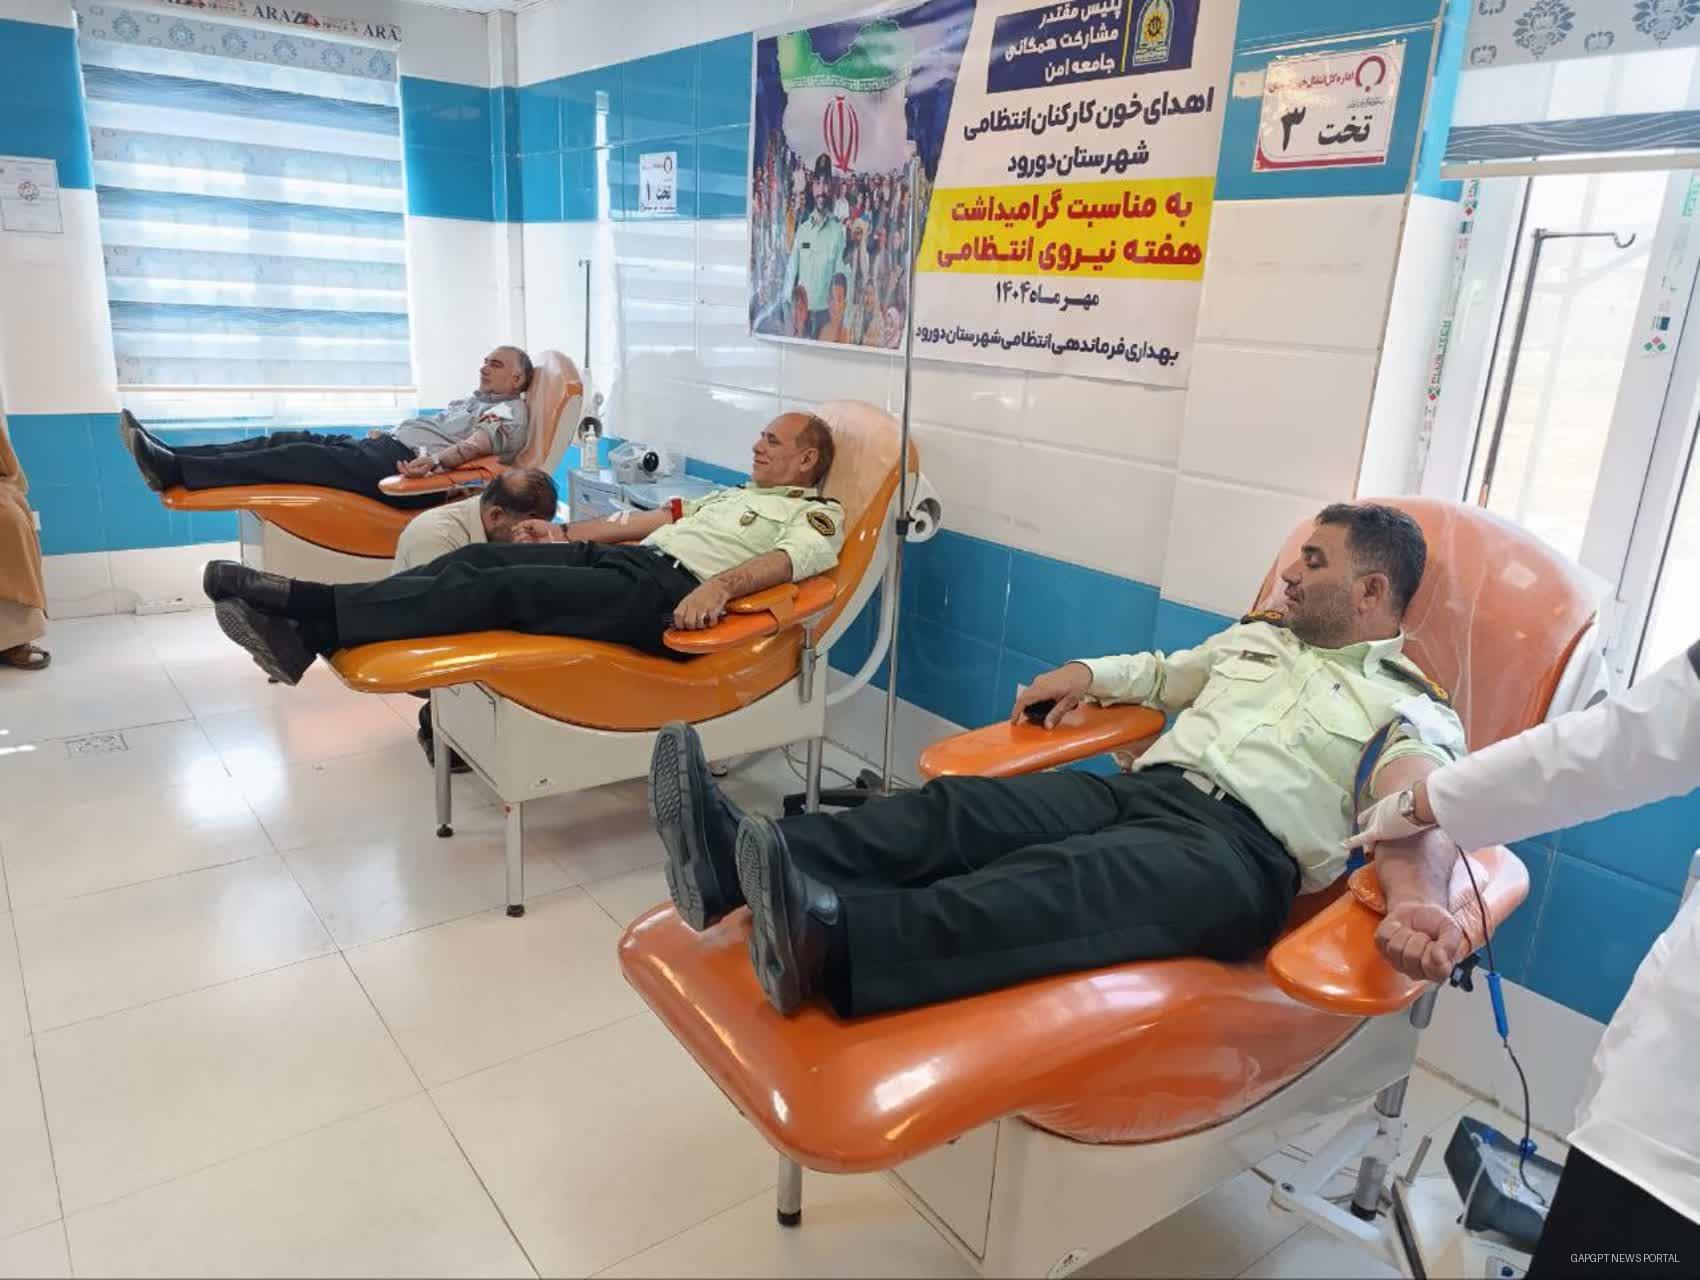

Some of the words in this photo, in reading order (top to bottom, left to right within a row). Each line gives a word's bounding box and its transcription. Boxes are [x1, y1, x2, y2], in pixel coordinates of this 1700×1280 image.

[1038, 3, 1079, 29] مقتدر
[1060, 22, 1119, 50] مشارکت
[1044, 60, 1070, 83] امن
[1072, 52, 1116, 75] جامعه
[1031, 99, 1097, 136] کارکنان
[1095, 92, 1144, 129] خون
[1143, 87, 1215, 125] اهدای
[963, 106, 1031, 141] انتظامی
[1281, 106, 1306, 152] ۳
[1318, 114, 1373, 146] تخت
[1007, 153, 1057, 178] دورود
[1056, 140, 1150, 176] شهرستان
[951, 189, 1063, 229] گرامیداشت
[1067, 191, 1157, 228] مناسبت
[1164, 193, 1193, 228] به
[937, 235, 1034, 268] انتظامی
[1038, 240, 1116, 272] نیروی
[1123, 234, 1201, 266] هفته
[995, 280, 1030, 304] ۱۴۰۴
[1030, 284, 1060, 304] ماه
[1059, 289, 1099, 311] مهر
[915, 326, 946, 343] دورود
[945, 325, 1001, 348] شهرستان
[1001, 330, 1051, 351] انتظامی
[1051, 336, 1126, 360] فرماندهی
[1126, 341, 1180, 366] بهداری
